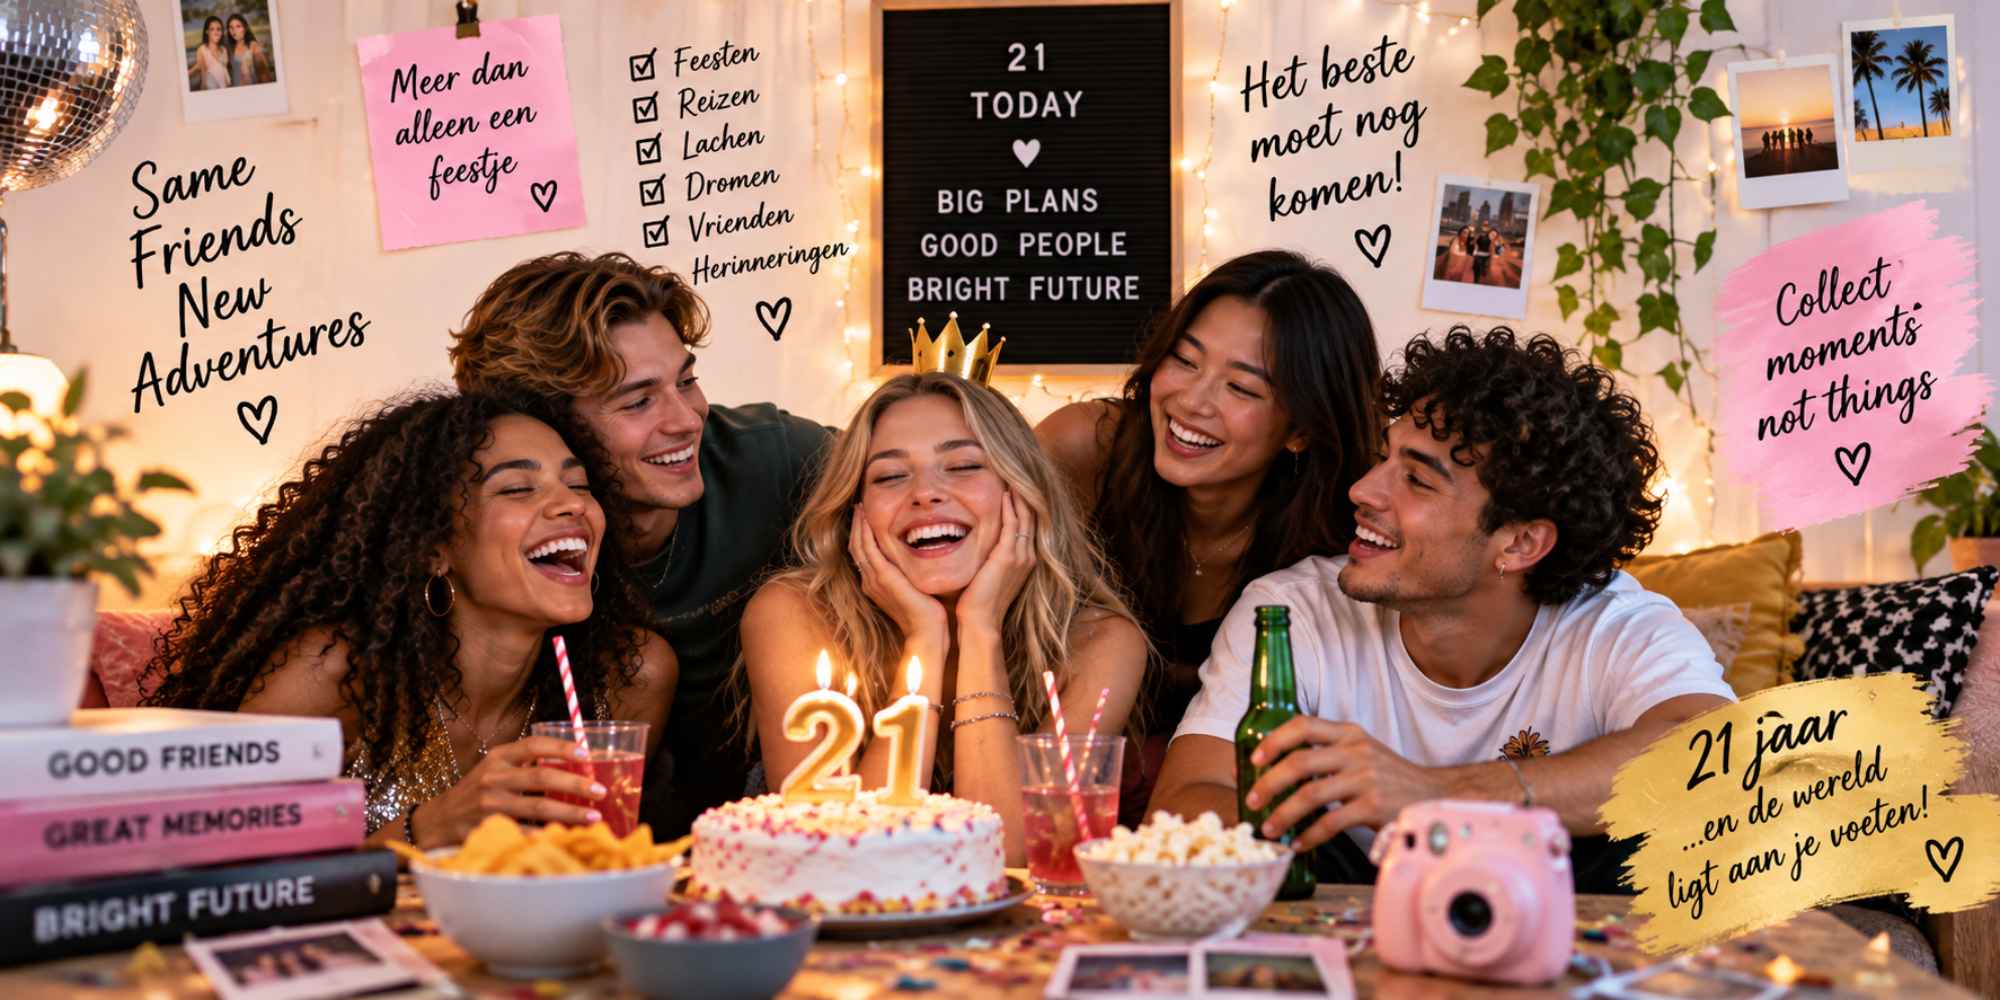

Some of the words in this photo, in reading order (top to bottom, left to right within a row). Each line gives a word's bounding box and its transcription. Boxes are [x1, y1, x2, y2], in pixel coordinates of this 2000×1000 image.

[1008, 43, 1045, 71] 21
[391, 63, 460, 103] Meer
[472, 51, 529, 85] dan
[970, 90, 1083, 119] TODAY
[395, 109, 480, 146] alleen
[489, 105, 537, 130] een
[429, 147, 518, 201] feestje
[938, 189, 983, 214] BIG
[1006, 188, 1098, 213] PLANS
[921, 233, 998, 257] GOOD
[1020, 231, 1127, 257] PEOPLE
[908, 276, 1010, 301] BRIGHT
[1030, 275, 1139, 300] FUTURE
[47, 747, 149, 779] GOOD
[160, 741, 280, 770] FRIENDS
[781, 689, 930, 804] 21
[44, 814, 150, 849] GREAT
[162, 803, 302, 835] MEMORIES
[33, 891, 176, 943] BRIGHT
[187, 876, 315, 919] FUTURE
